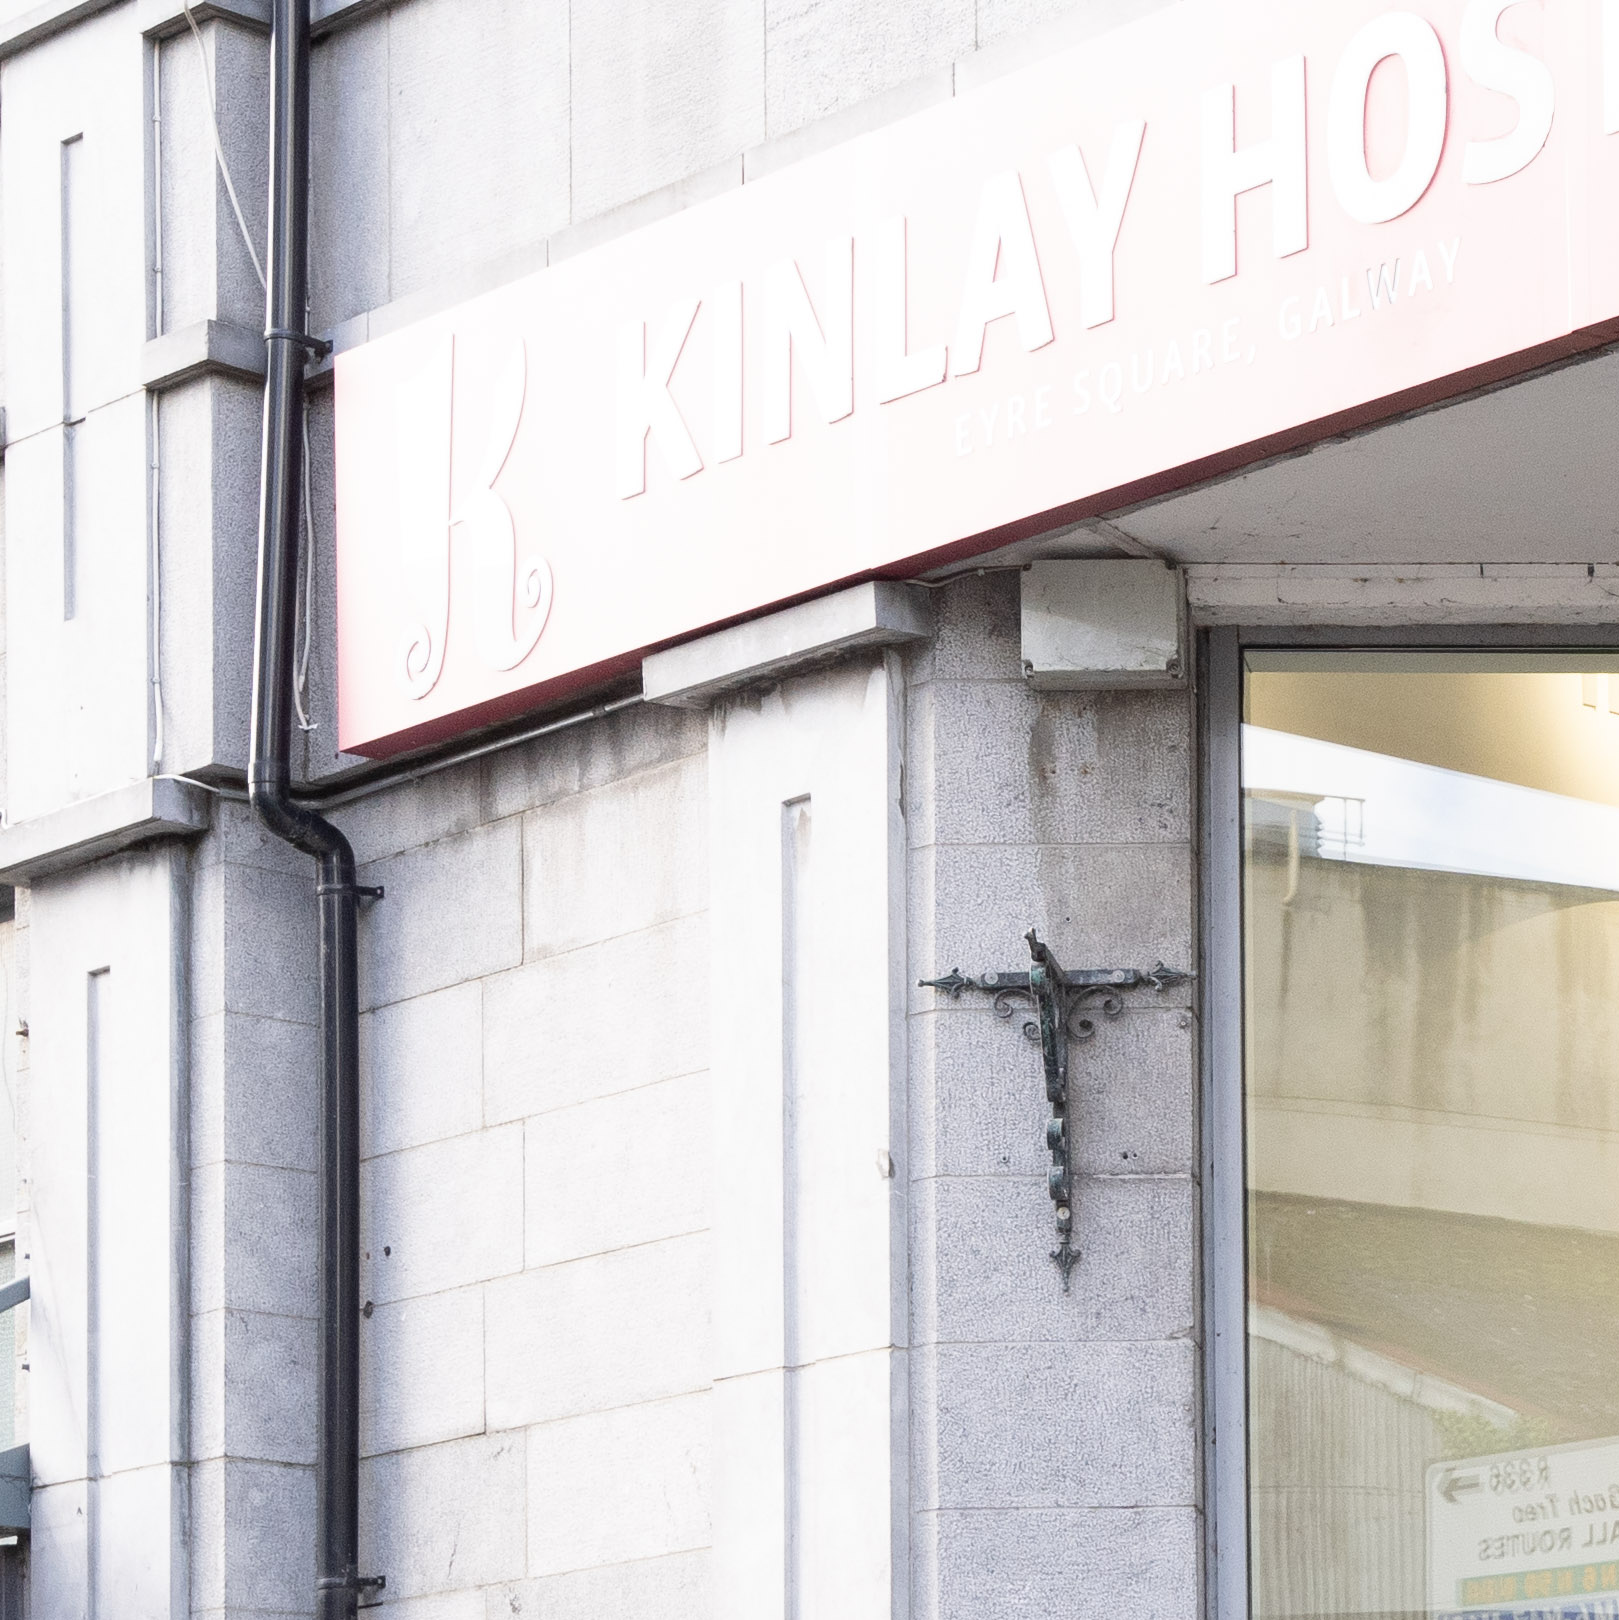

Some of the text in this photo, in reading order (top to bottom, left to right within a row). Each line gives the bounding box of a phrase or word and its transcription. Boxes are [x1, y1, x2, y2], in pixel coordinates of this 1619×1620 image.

[616, 118, 1148, 501] KINLAY
[953, 384, 1058, 460] EYRE
[1278, 236, 1463, 340] GALWAY
